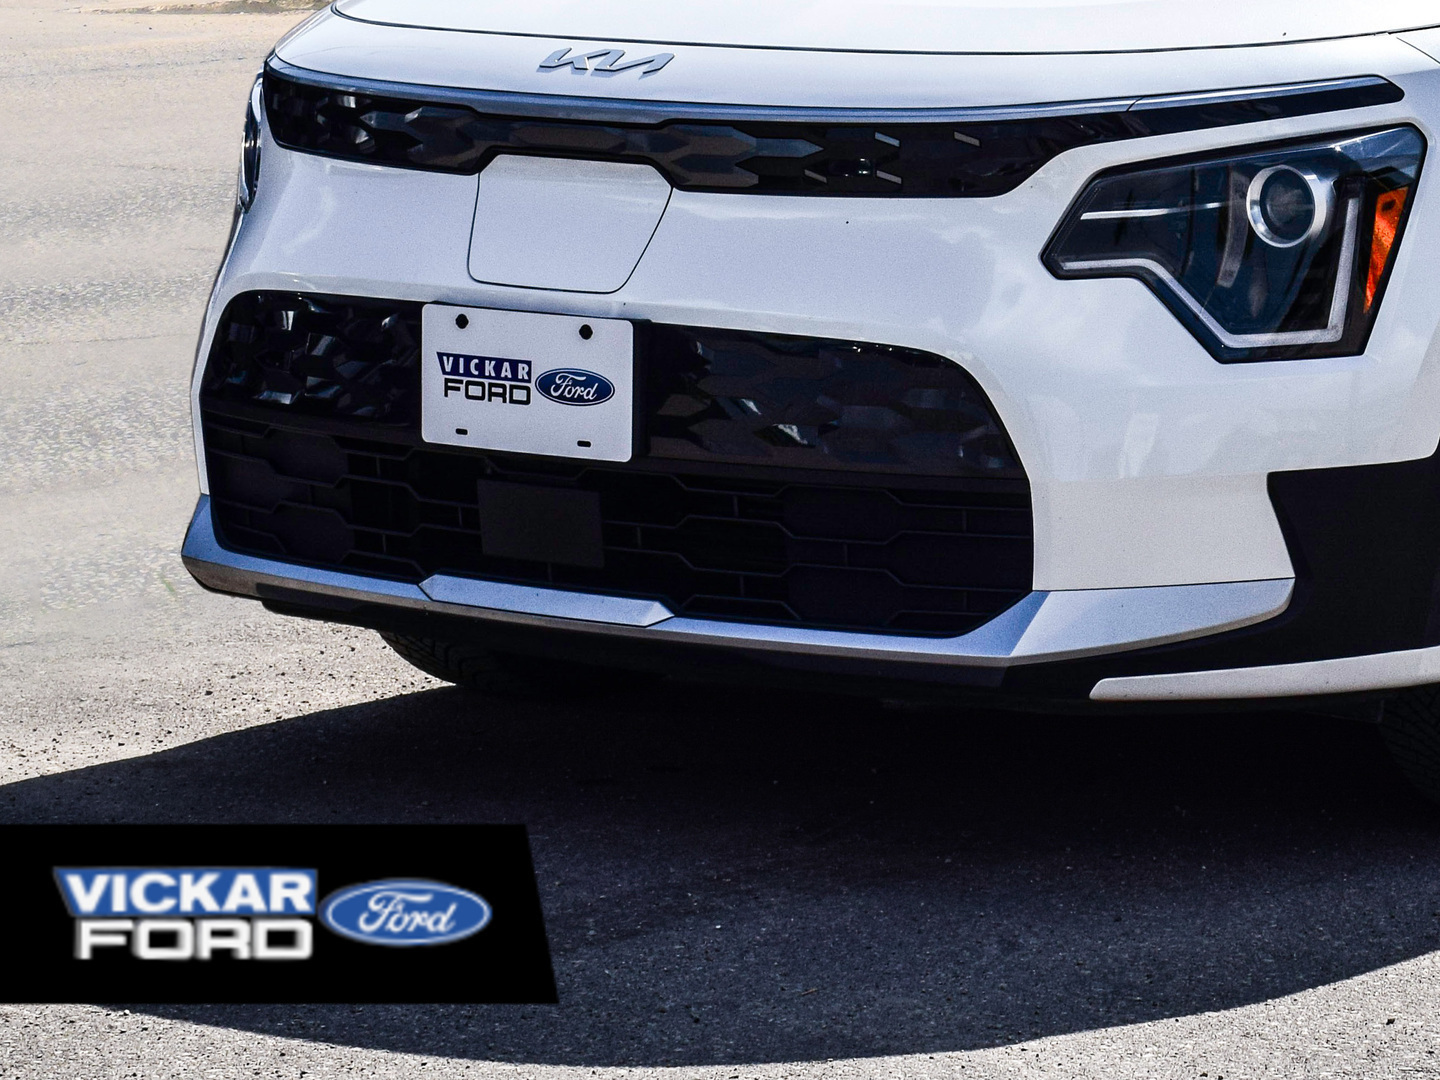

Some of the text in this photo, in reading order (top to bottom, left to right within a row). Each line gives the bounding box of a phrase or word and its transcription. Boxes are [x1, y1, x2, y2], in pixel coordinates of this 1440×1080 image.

[538, 46, 677, 75] KIA
[442, 355, 530, 380] VICKAR
[443, 372, 599, 406] FORD Ford
